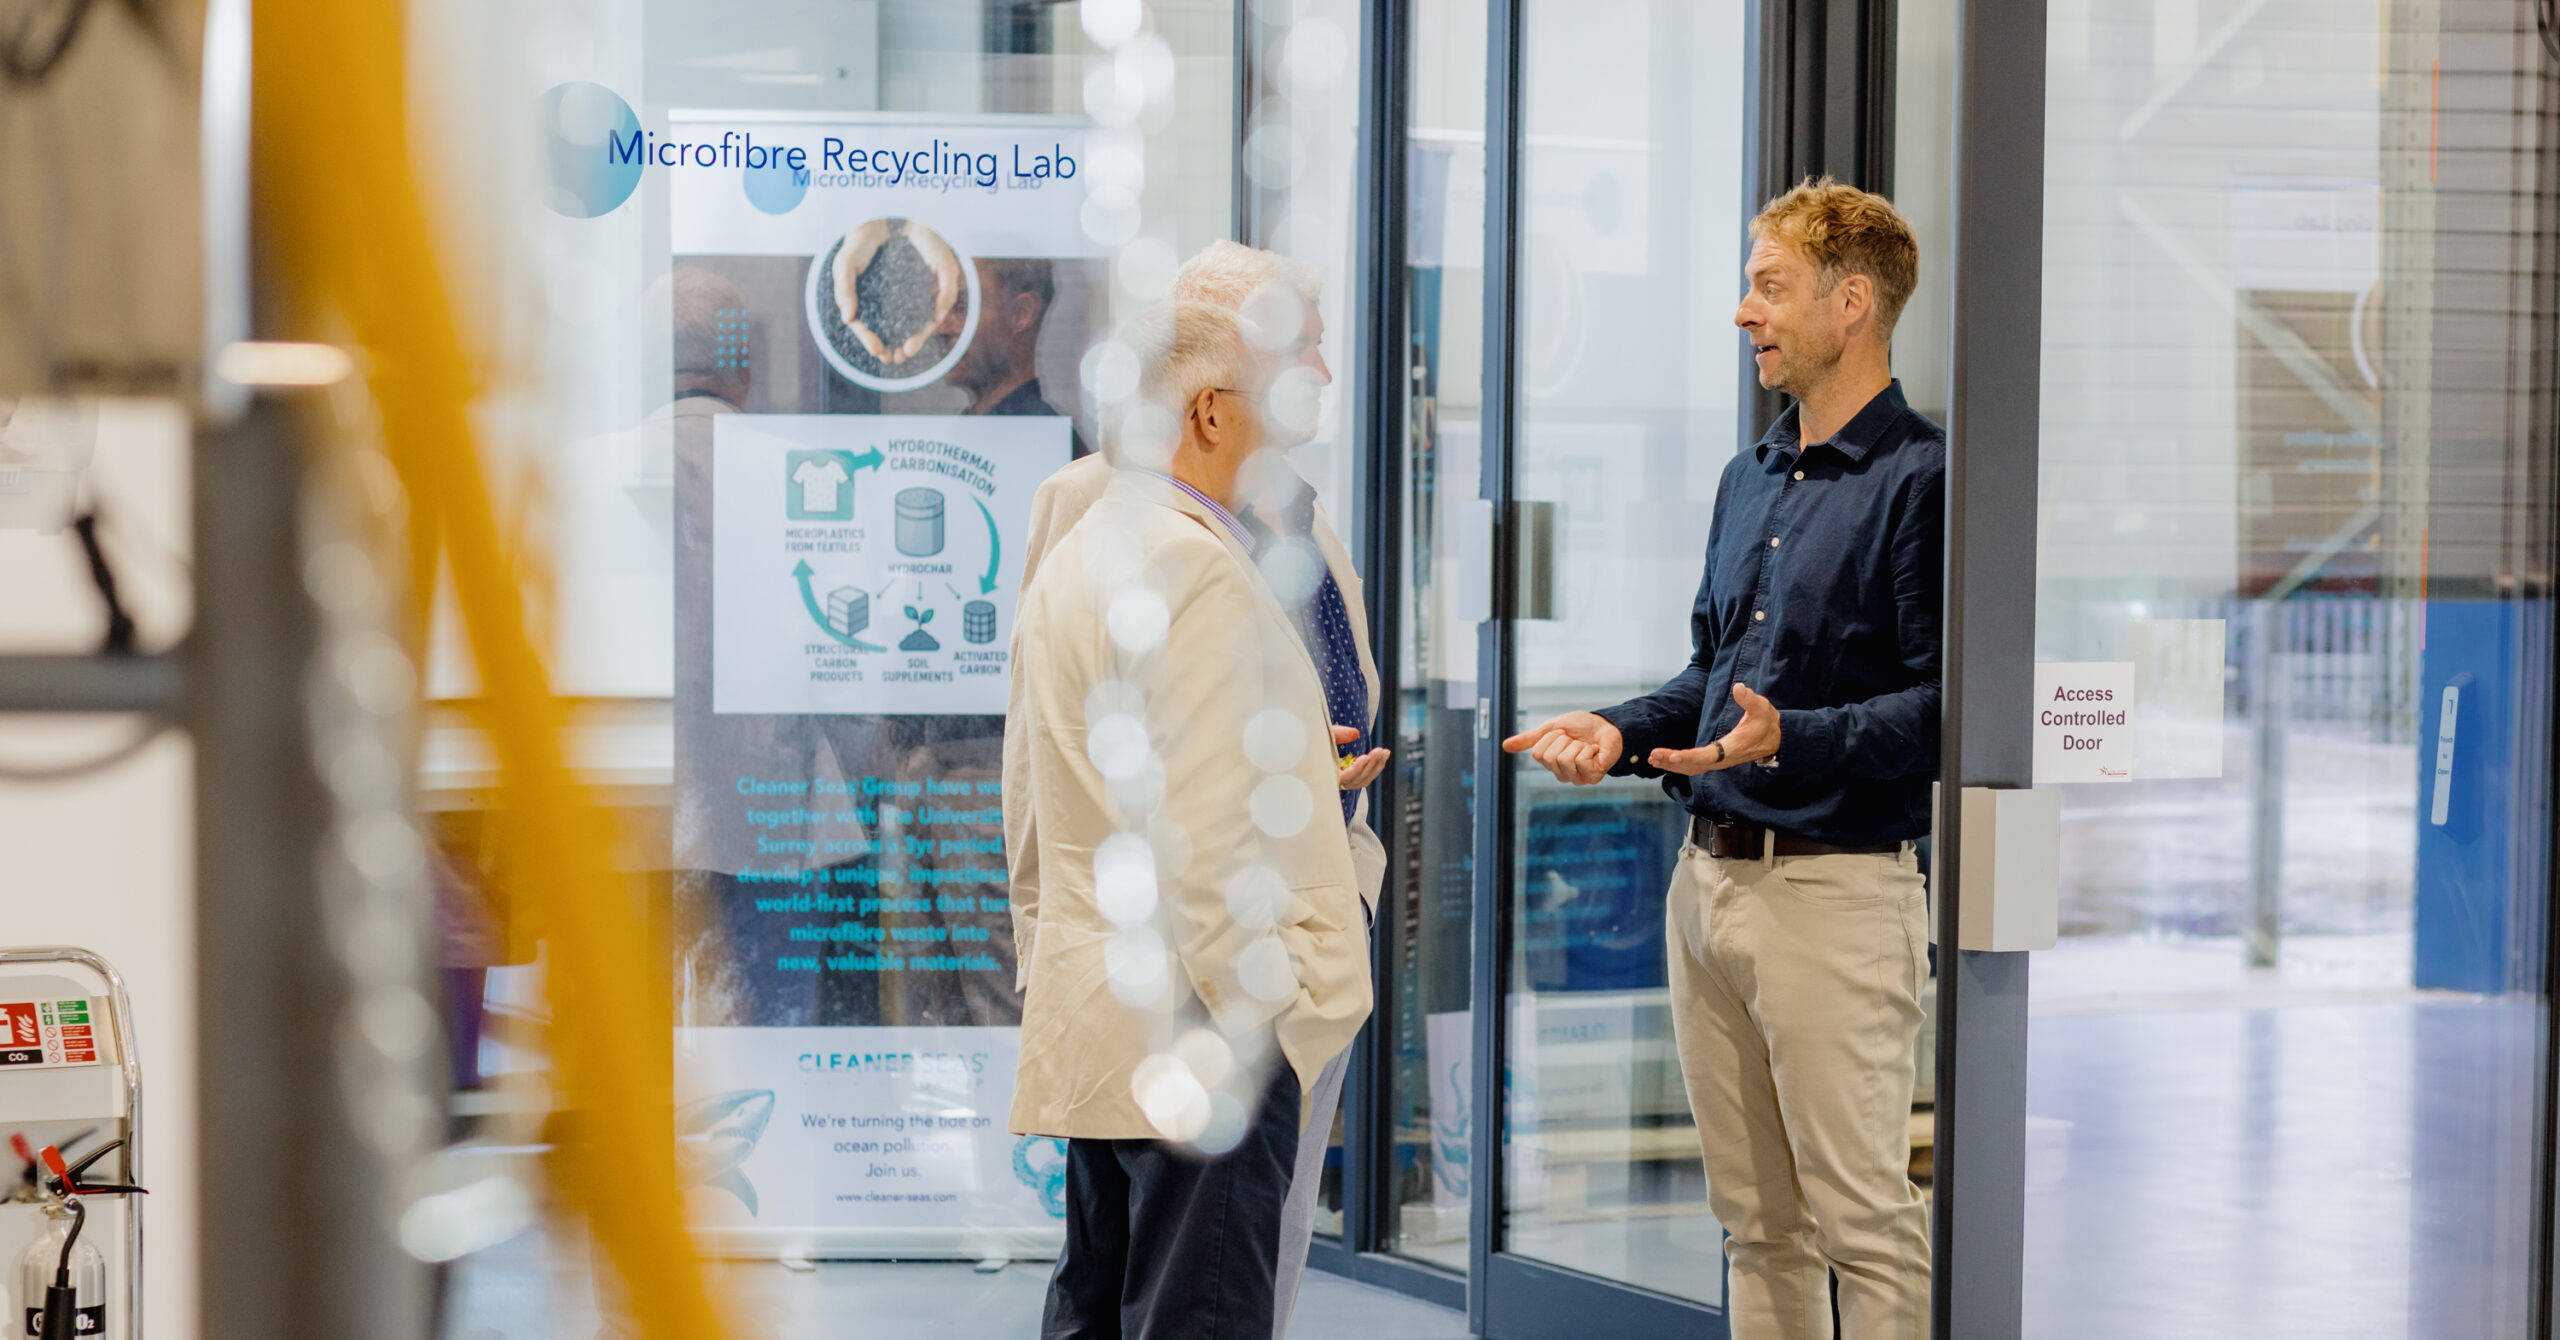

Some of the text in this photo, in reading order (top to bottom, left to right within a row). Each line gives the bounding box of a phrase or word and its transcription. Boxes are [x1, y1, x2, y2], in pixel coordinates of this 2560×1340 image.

[608, 129, 1076, 187] Microfibre Recycling Lab
[792, 169, 1042, 194] Microfibre Recycling Lab
[888, 439, 996, 477] HYDROTHERMAL
[890, 457, 997, 497] CARBONISATION
[785, 528, 865, 539] MICROPLASTICS
[785, 542, 861, 552] FROM TEXTILES
[888, 563, 953, 575] HYDROCHAR
[804, 644, 869, 656] STRUCTURAL
[953, 651, 1008, 662] ACTIVATED
[814, 658, 857, 668] CARBON
[908, 658, 929, 669] SOIL
[959, 664, 1001, 675] CARBON
[810, 671, 864, 682] PRODUCTS
[882, 671, 954, 682] SUPPLEMENTS
[2053, 685, 2113, 701] Access
[2041, 710, 2125, 726] Controlled
[2063, 734, 2103, 750] Door
[736, 776, 809, 795] Cleaner
[814, 776, 857, 796] Seas
[862, 777, 921, 799] Group
[926, 776, 971, 795] have
[746, 804, 830, 829] together
[834, 805, 877, 825] with
[882, 806, 914, 825] the
[757, 835, 1003, 858] Surrey across a 3yr period
[737, 863, 814, 887] develop
[818, 869, 831, 884] a
[909, 864, 1008, 888] impactless
[755, 892, 1011, 917] world-first process that tur
[789, 921, 990, 942] microfibre waste into
[777, 951, 1003, 973] new, valuable materials.
[801, 1114, 847, 1128] We're
[851, 1113, 905, 1132] turning
[909, 1114, 934, 1128] the
[972, 1116, 991, 1128] on
[833, 1140, 879, 1152] ocean
[865, 1162, 897, 1178] Join
